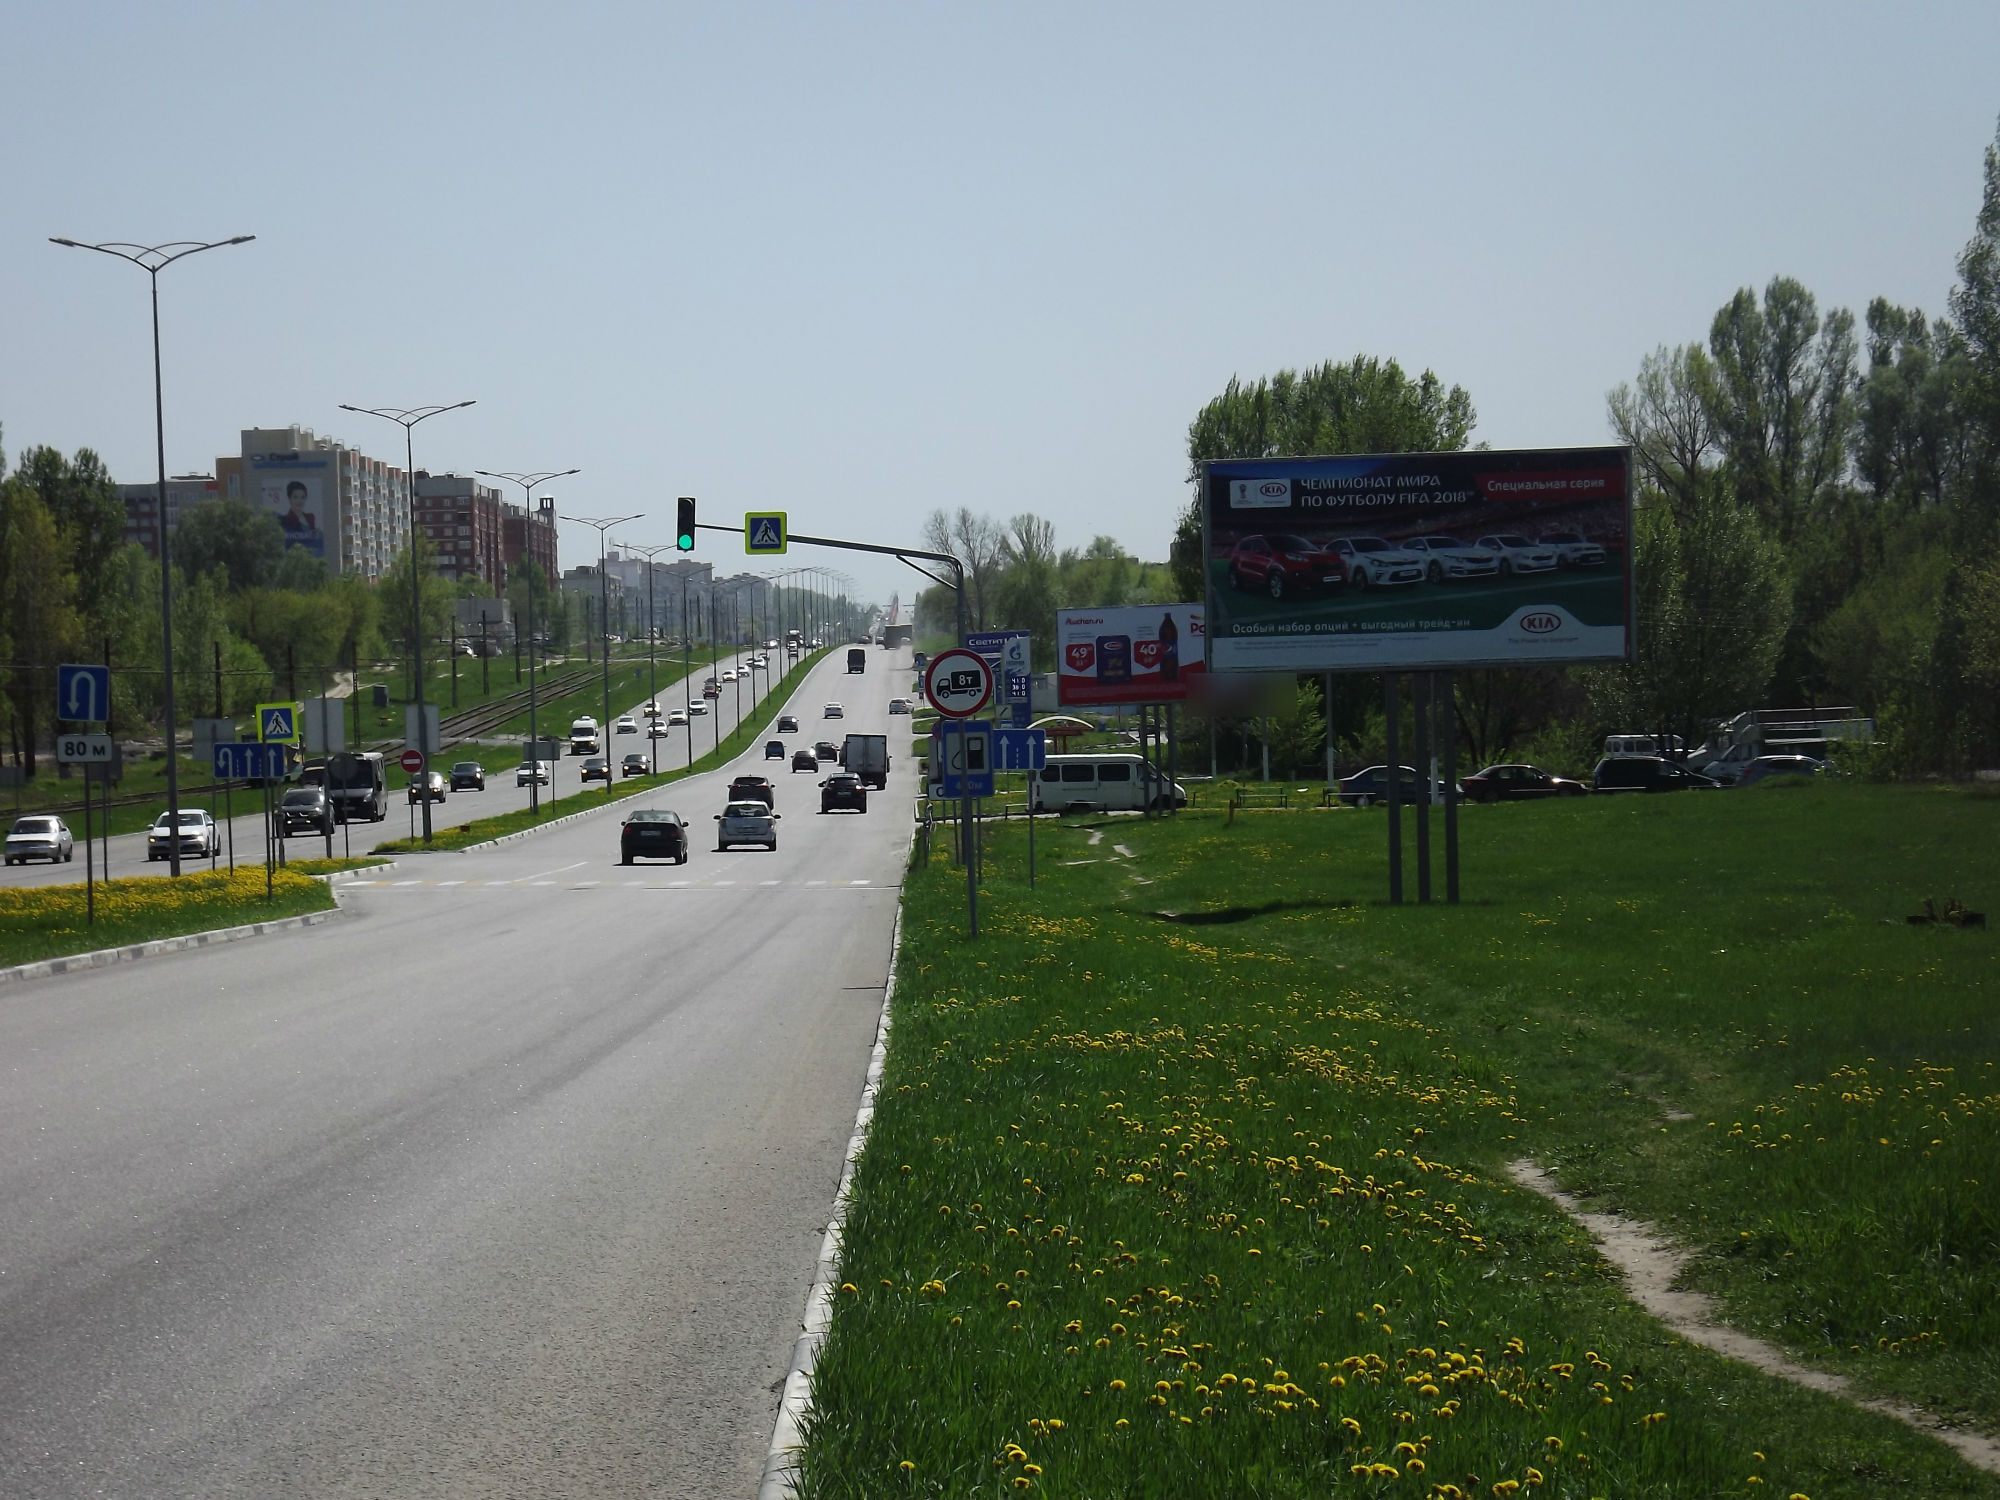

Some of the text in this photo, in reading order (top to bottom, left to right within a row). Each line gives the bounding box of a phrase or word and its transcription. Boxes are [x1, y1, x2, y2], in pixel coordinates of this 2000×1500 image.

[1301, 474, 1440, 490] ЧЕМПИОНАТ МИРА
[1487, 478, 1605, 492] Специальная серия
[1264, 485, 1283, 495] KIA
[1302, 495, 1323, 507] ПО
[1326, 492, 1395, 506] ФУТБОЛУ
[1400, 492, 1430, 505] FIFA
[1232, 622, 1275, 634] Особый
[1278, 622, 1311, 633] набор
[1315, 621, 1349, 633] опций
[1361, 619, 1416, 632] выгодный
[1419, 618, 1471, 630] трейд-ин
[1527, 616, 1555, 629] KIA
[1139, 644, 1157, 655] 40
[64, 741, 105, 756] 80 м
